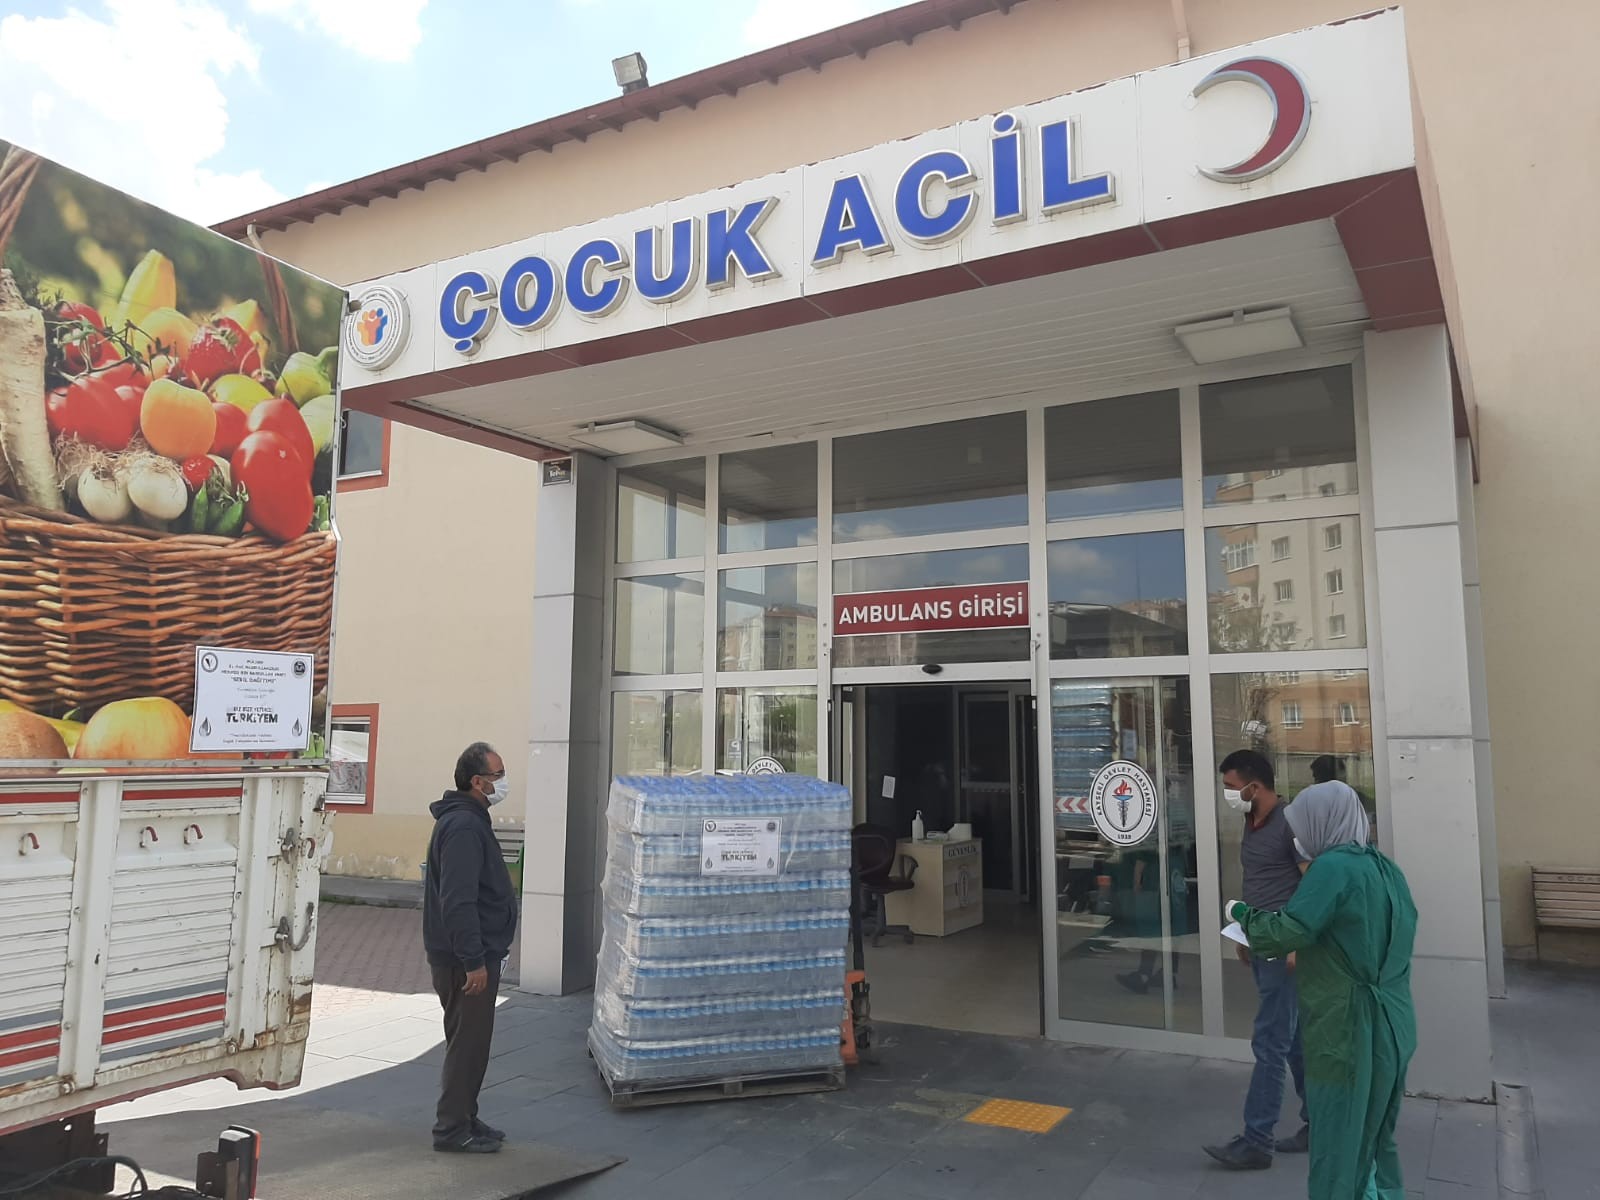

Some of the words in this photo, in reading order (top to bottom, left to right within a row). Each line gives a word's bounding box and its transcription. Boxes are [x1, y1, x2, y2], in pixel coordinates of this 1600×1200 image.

[438, 197, 780, 356] ÇOCUK
[811, 112, 1115, 268] ACİL
[839, 600, 952, 625] AMBULANS
[958, 591, 1023, 618] GİRİŞİ
[1103, 767, 1131, 780] DEVLET
